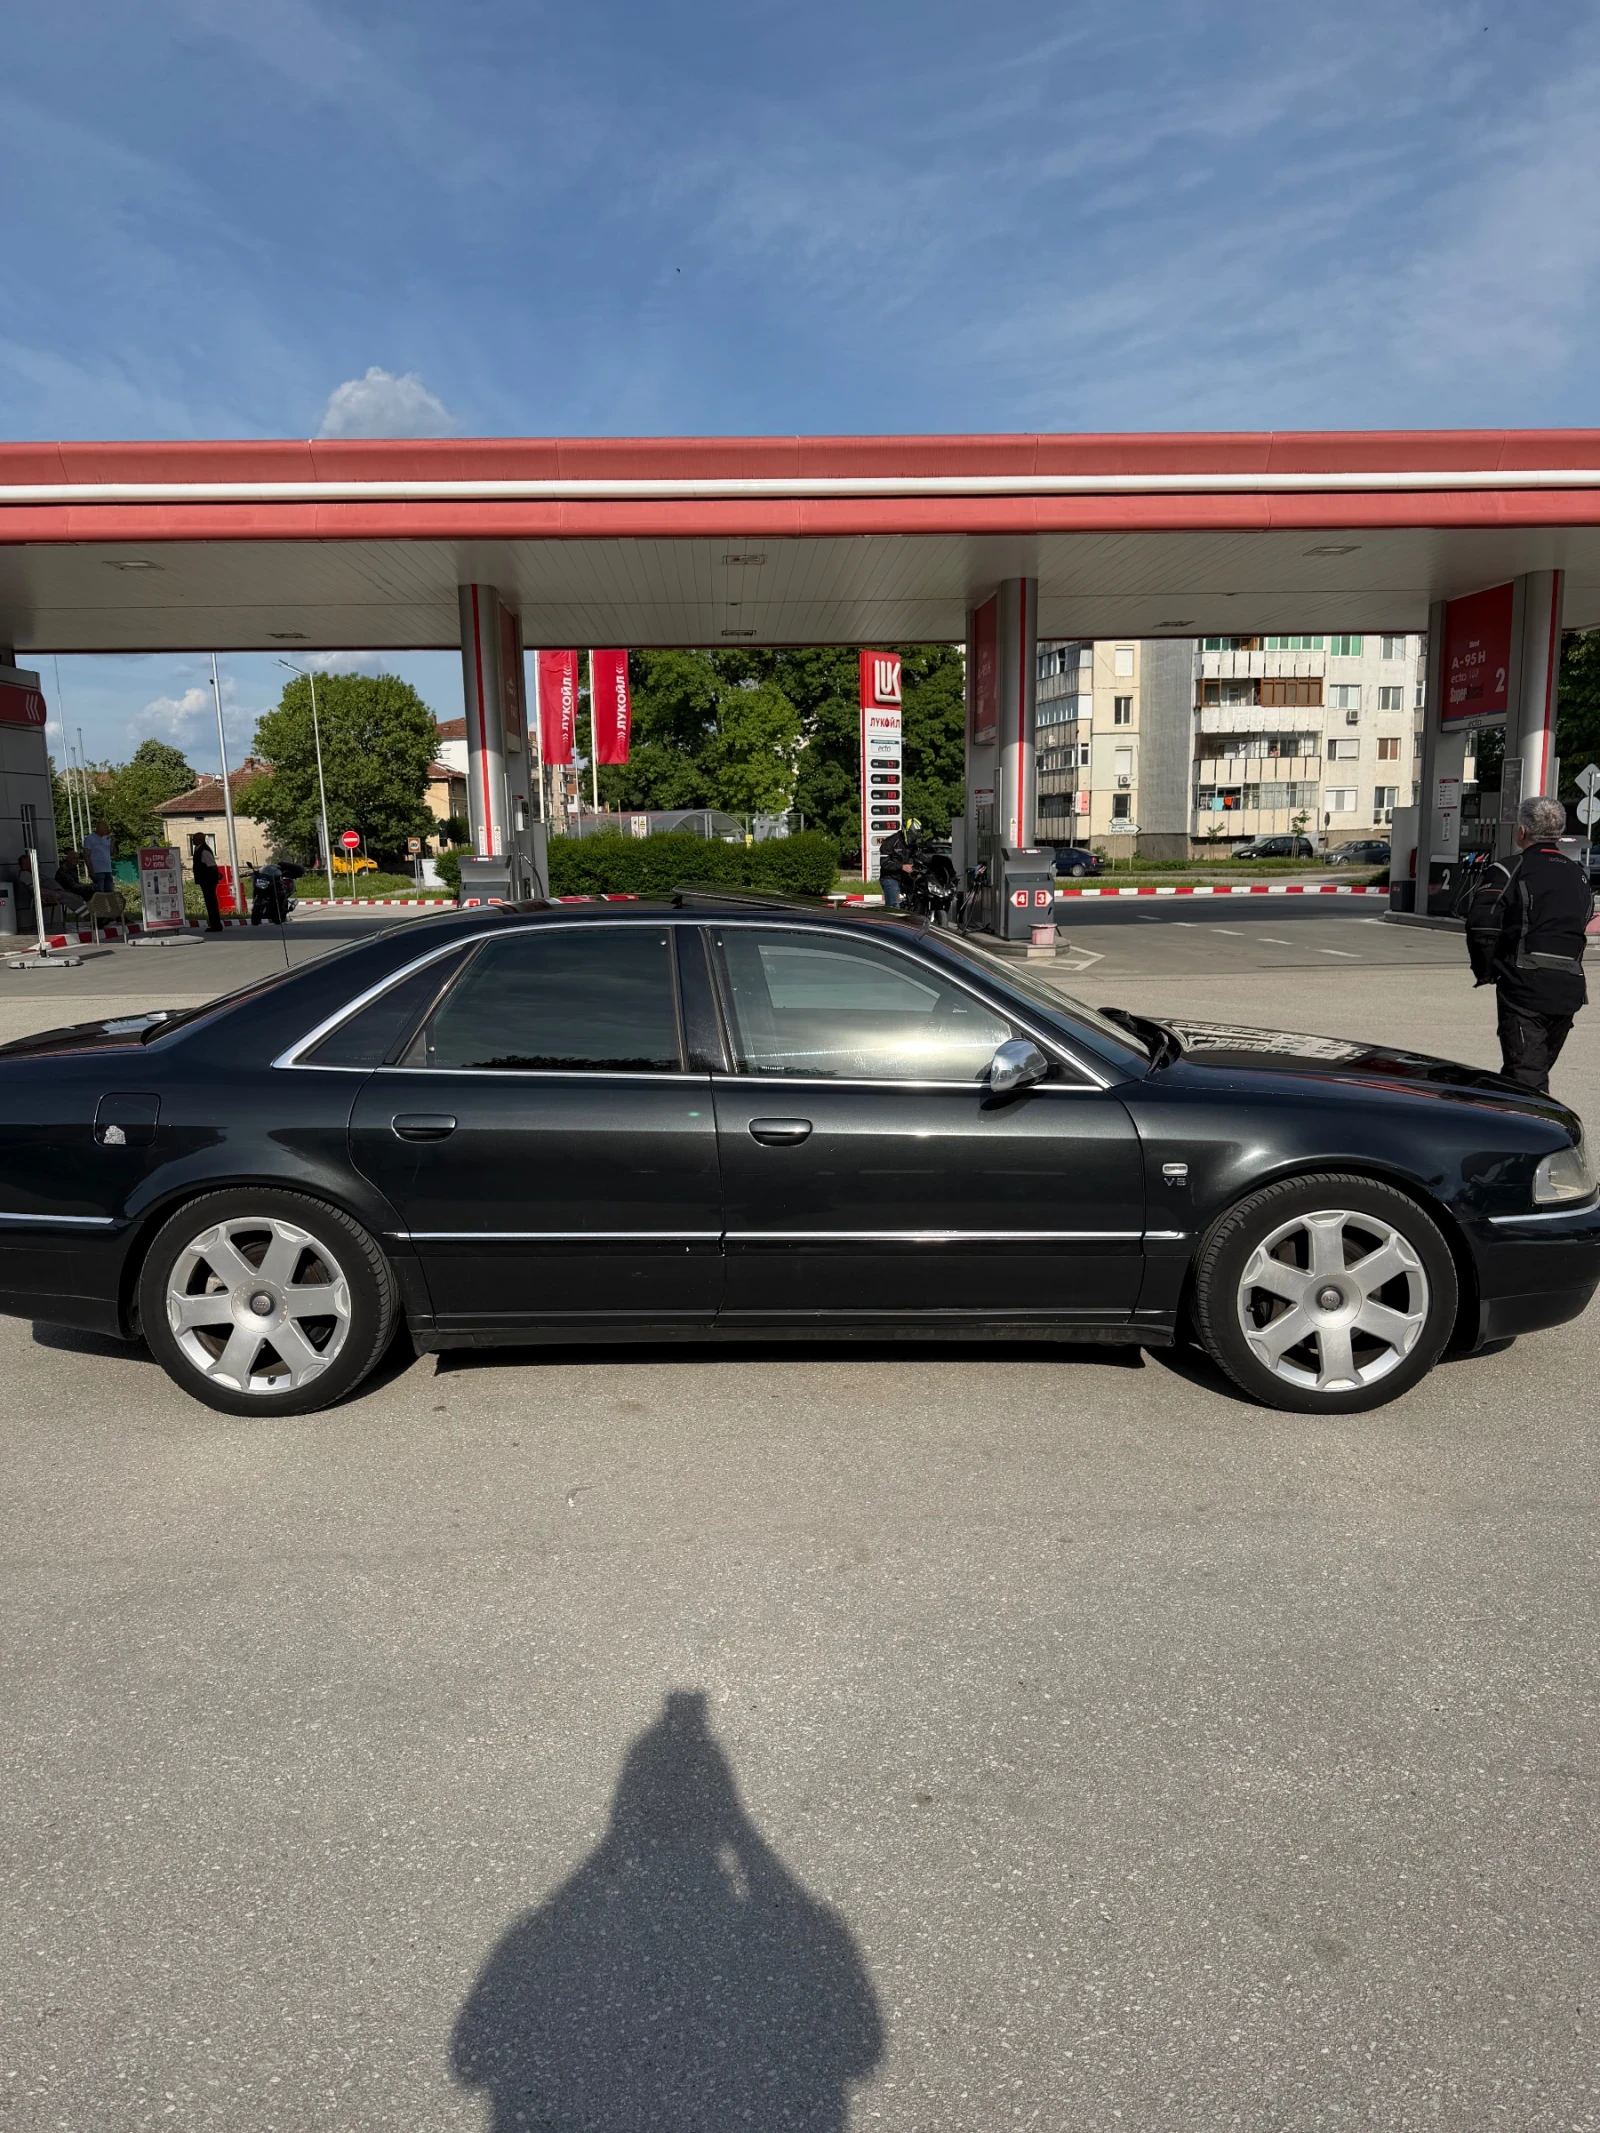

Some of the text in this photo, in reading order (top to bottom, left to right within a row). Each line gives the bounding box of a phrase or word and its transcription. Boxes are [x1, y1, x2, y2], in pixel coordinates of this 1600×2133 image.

[1450, 673, 1467, 683] ecto
[1494, 667, 1506, 693] 2
[561, 677, 572, 731] ЛУКОЙЛ
[615, 675, 627, 730] ЛУКОЙЛ
[870, 717, 900, 728] ЛУКОЙЛ
[1468, 719, 1482, 728] ecto
[877, 745, 891, 753] ecto
[1441, 868, 1451, 890] 2
[1017, 894, 1026, 904] 4
[1037, 894, 1045, 904] 3
[1163, 1177, 1187, 1187] V8
